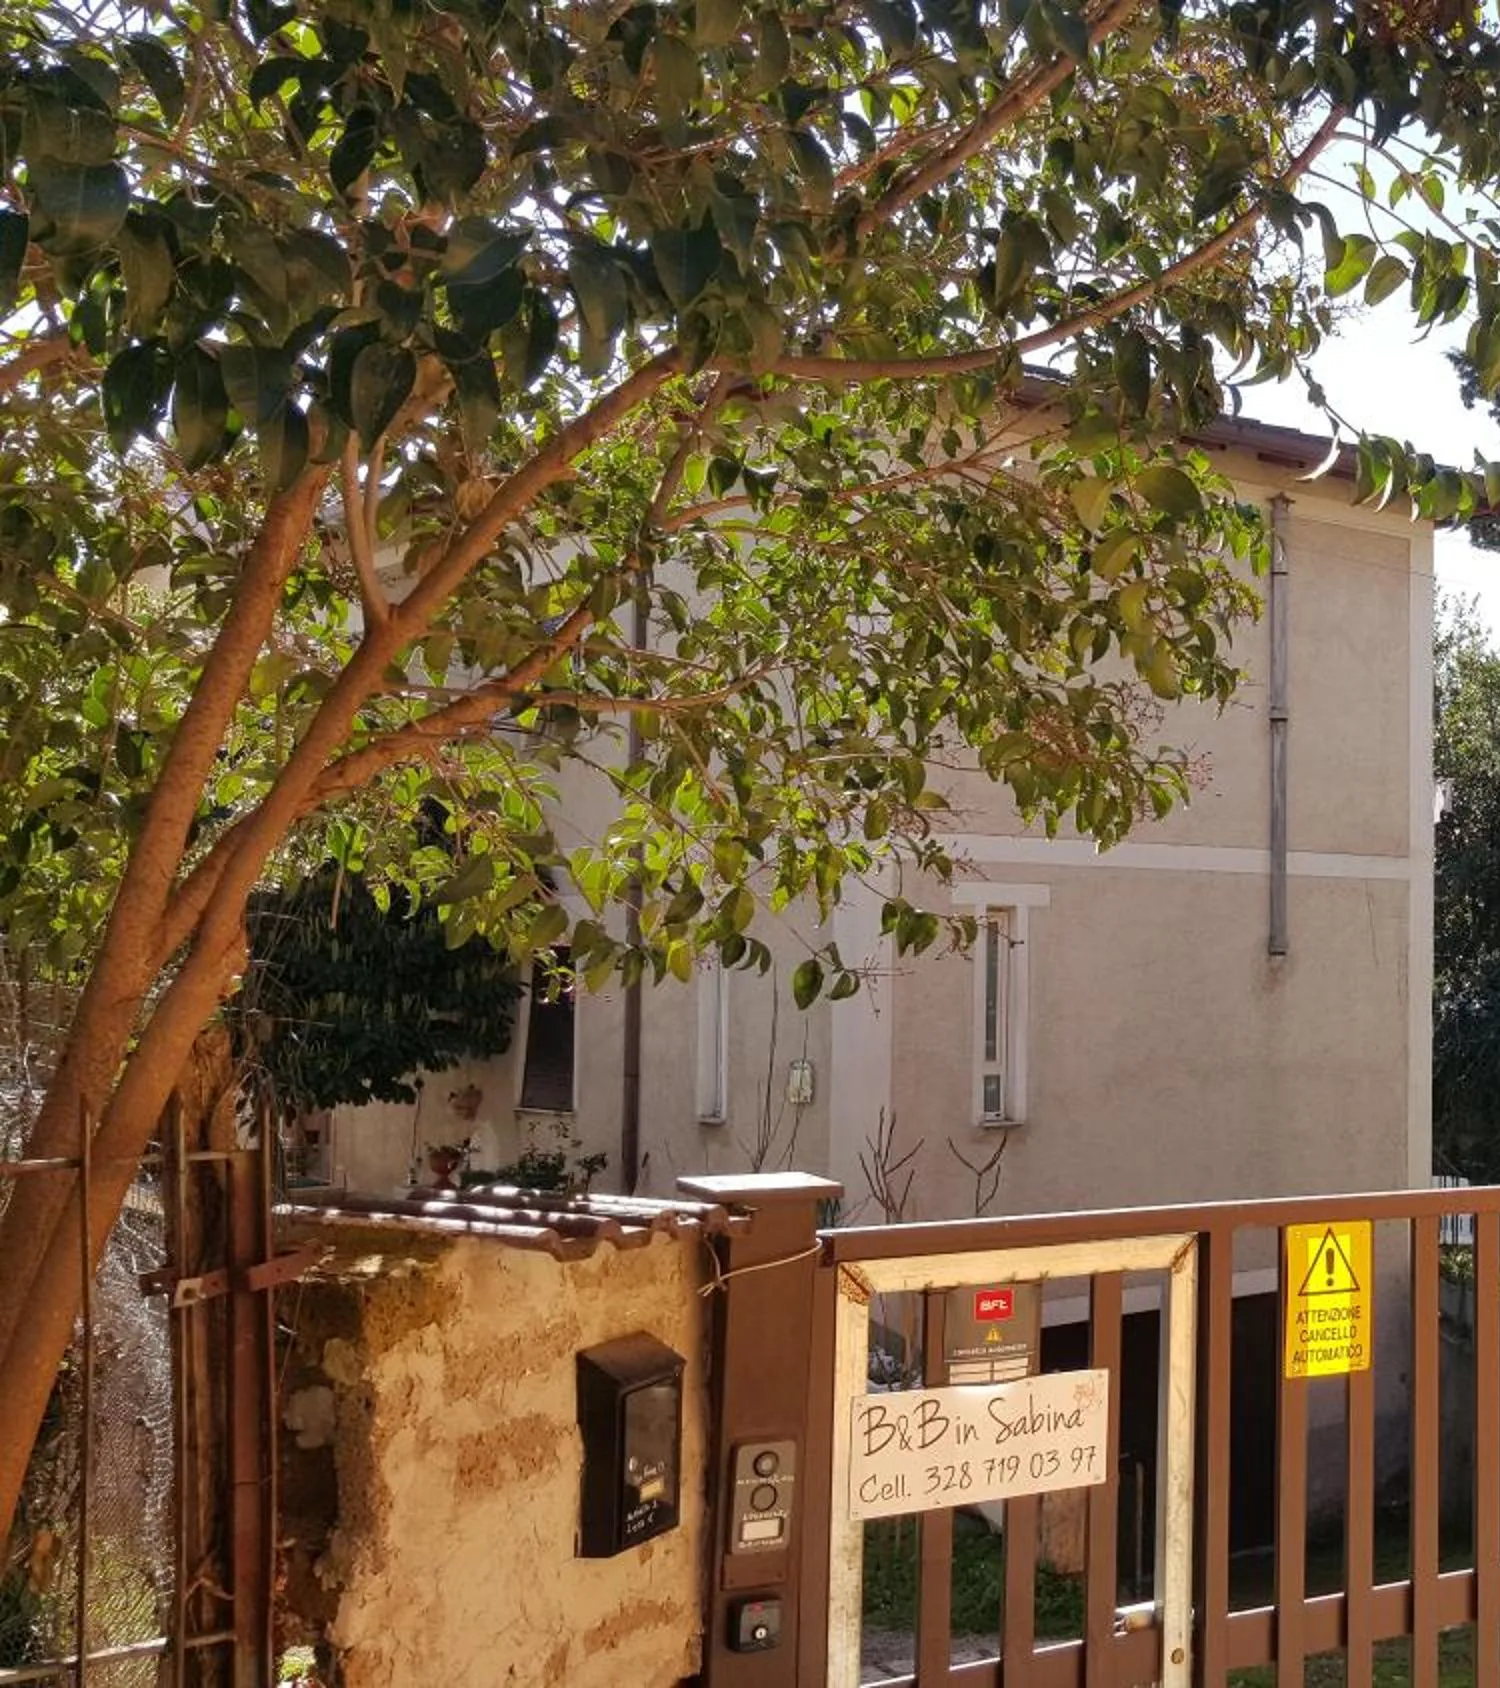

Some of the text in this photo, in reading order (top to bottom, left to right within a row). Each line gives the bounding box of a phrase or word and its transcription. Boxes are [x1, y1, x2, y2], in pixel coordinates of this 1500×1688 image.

[1295, 1305, 1361, 1325] ATTENZIONE
[1299, 1325, 1357, 1343] CANCELLO
[1292, 1344, 1363, 1364] AUTOMATICO
[858, 1393, 1085, 1457] B&B in Sabina
[858, 1444, 1097, 1504] Cell. 328 719 03 97
